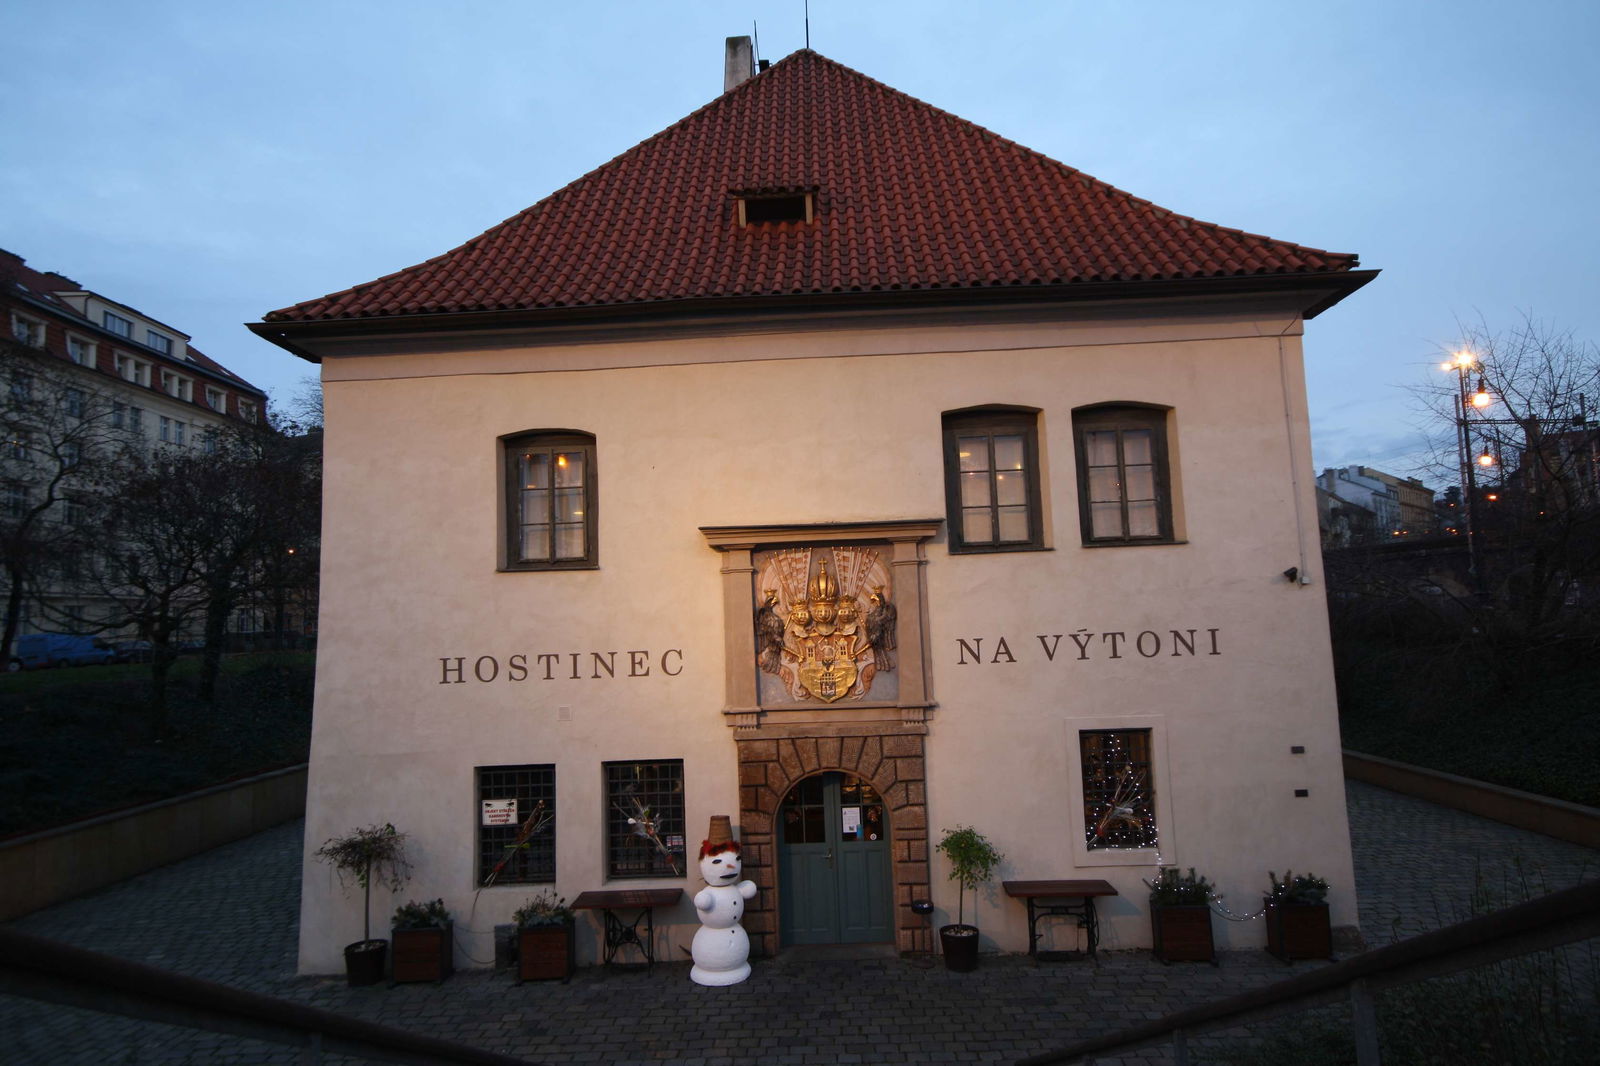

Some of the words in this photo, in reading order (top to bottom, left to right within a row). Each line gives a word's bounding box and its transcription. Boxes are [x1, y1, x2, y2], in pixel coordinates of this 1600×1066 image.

[439, 649, 683, 684] HOSTINEC
[956, 637, 1017, 665] NA
[1037, 629, 1221, 661] VÝTONI
